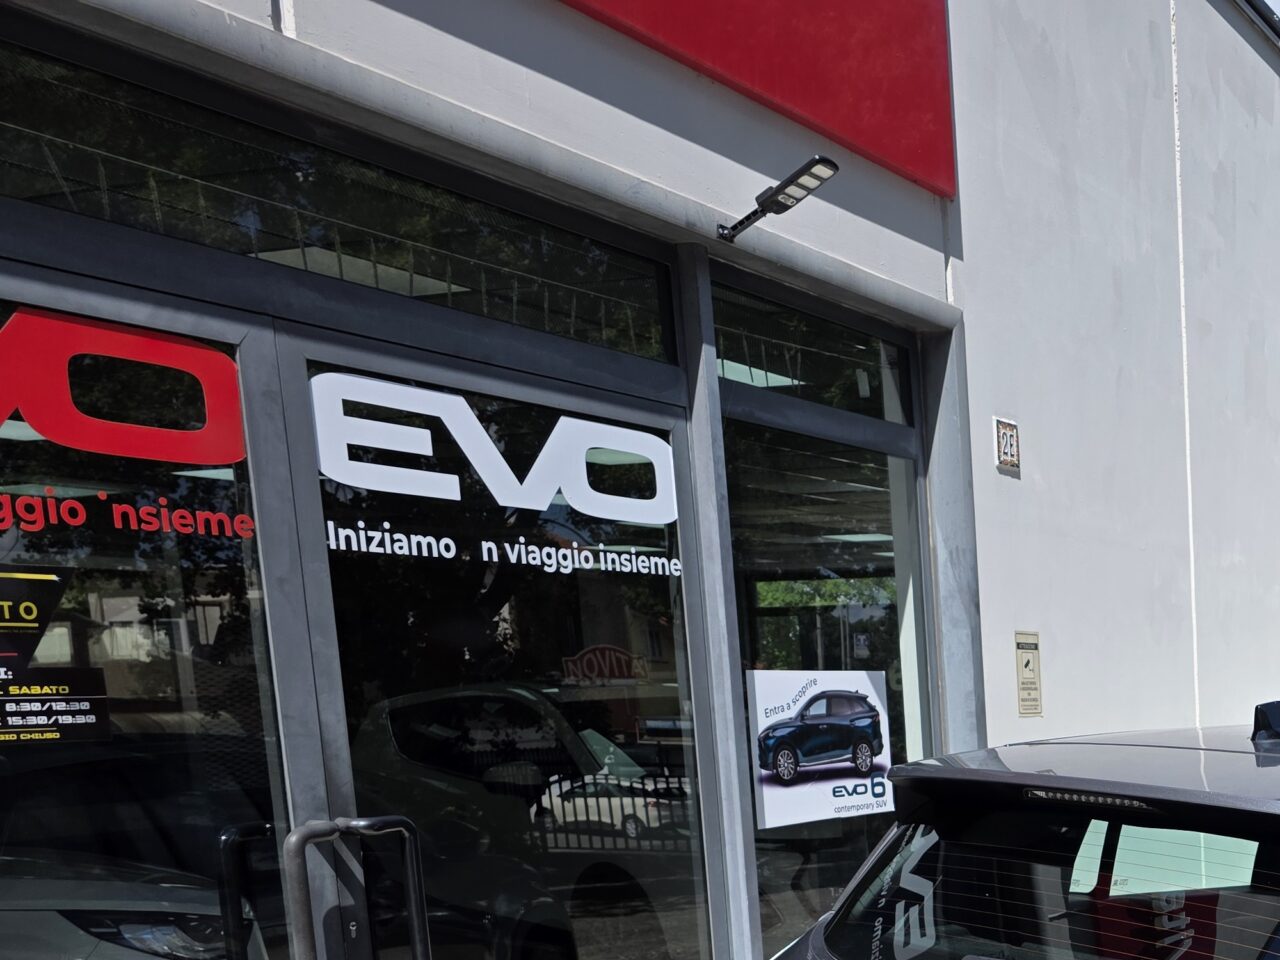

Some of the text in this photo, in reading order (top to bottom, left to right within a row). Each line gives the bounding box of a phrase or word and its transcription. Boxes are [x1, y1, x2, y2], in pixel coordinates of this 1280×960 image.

[309, 372, 678, 525] EVO
[97, 490, 255, 539] nsieme
[327, 520, 457, 559] Iniziamo
[504, 536, 593, 575] viaggio
[599, 543, 682, 577] insieme
[8, 685, 69, 694] SABATO
[764, 702, 785, 718] Entra
[791, 677, 818, 706] scoprire
[5, 701, 90, 711] 8:30/12:30
[6, 714, 96, 725] 15:30/19:30
[832, 771, 886, 798] EVO 6
[833, 799, 888, 813] contemporary SUV
